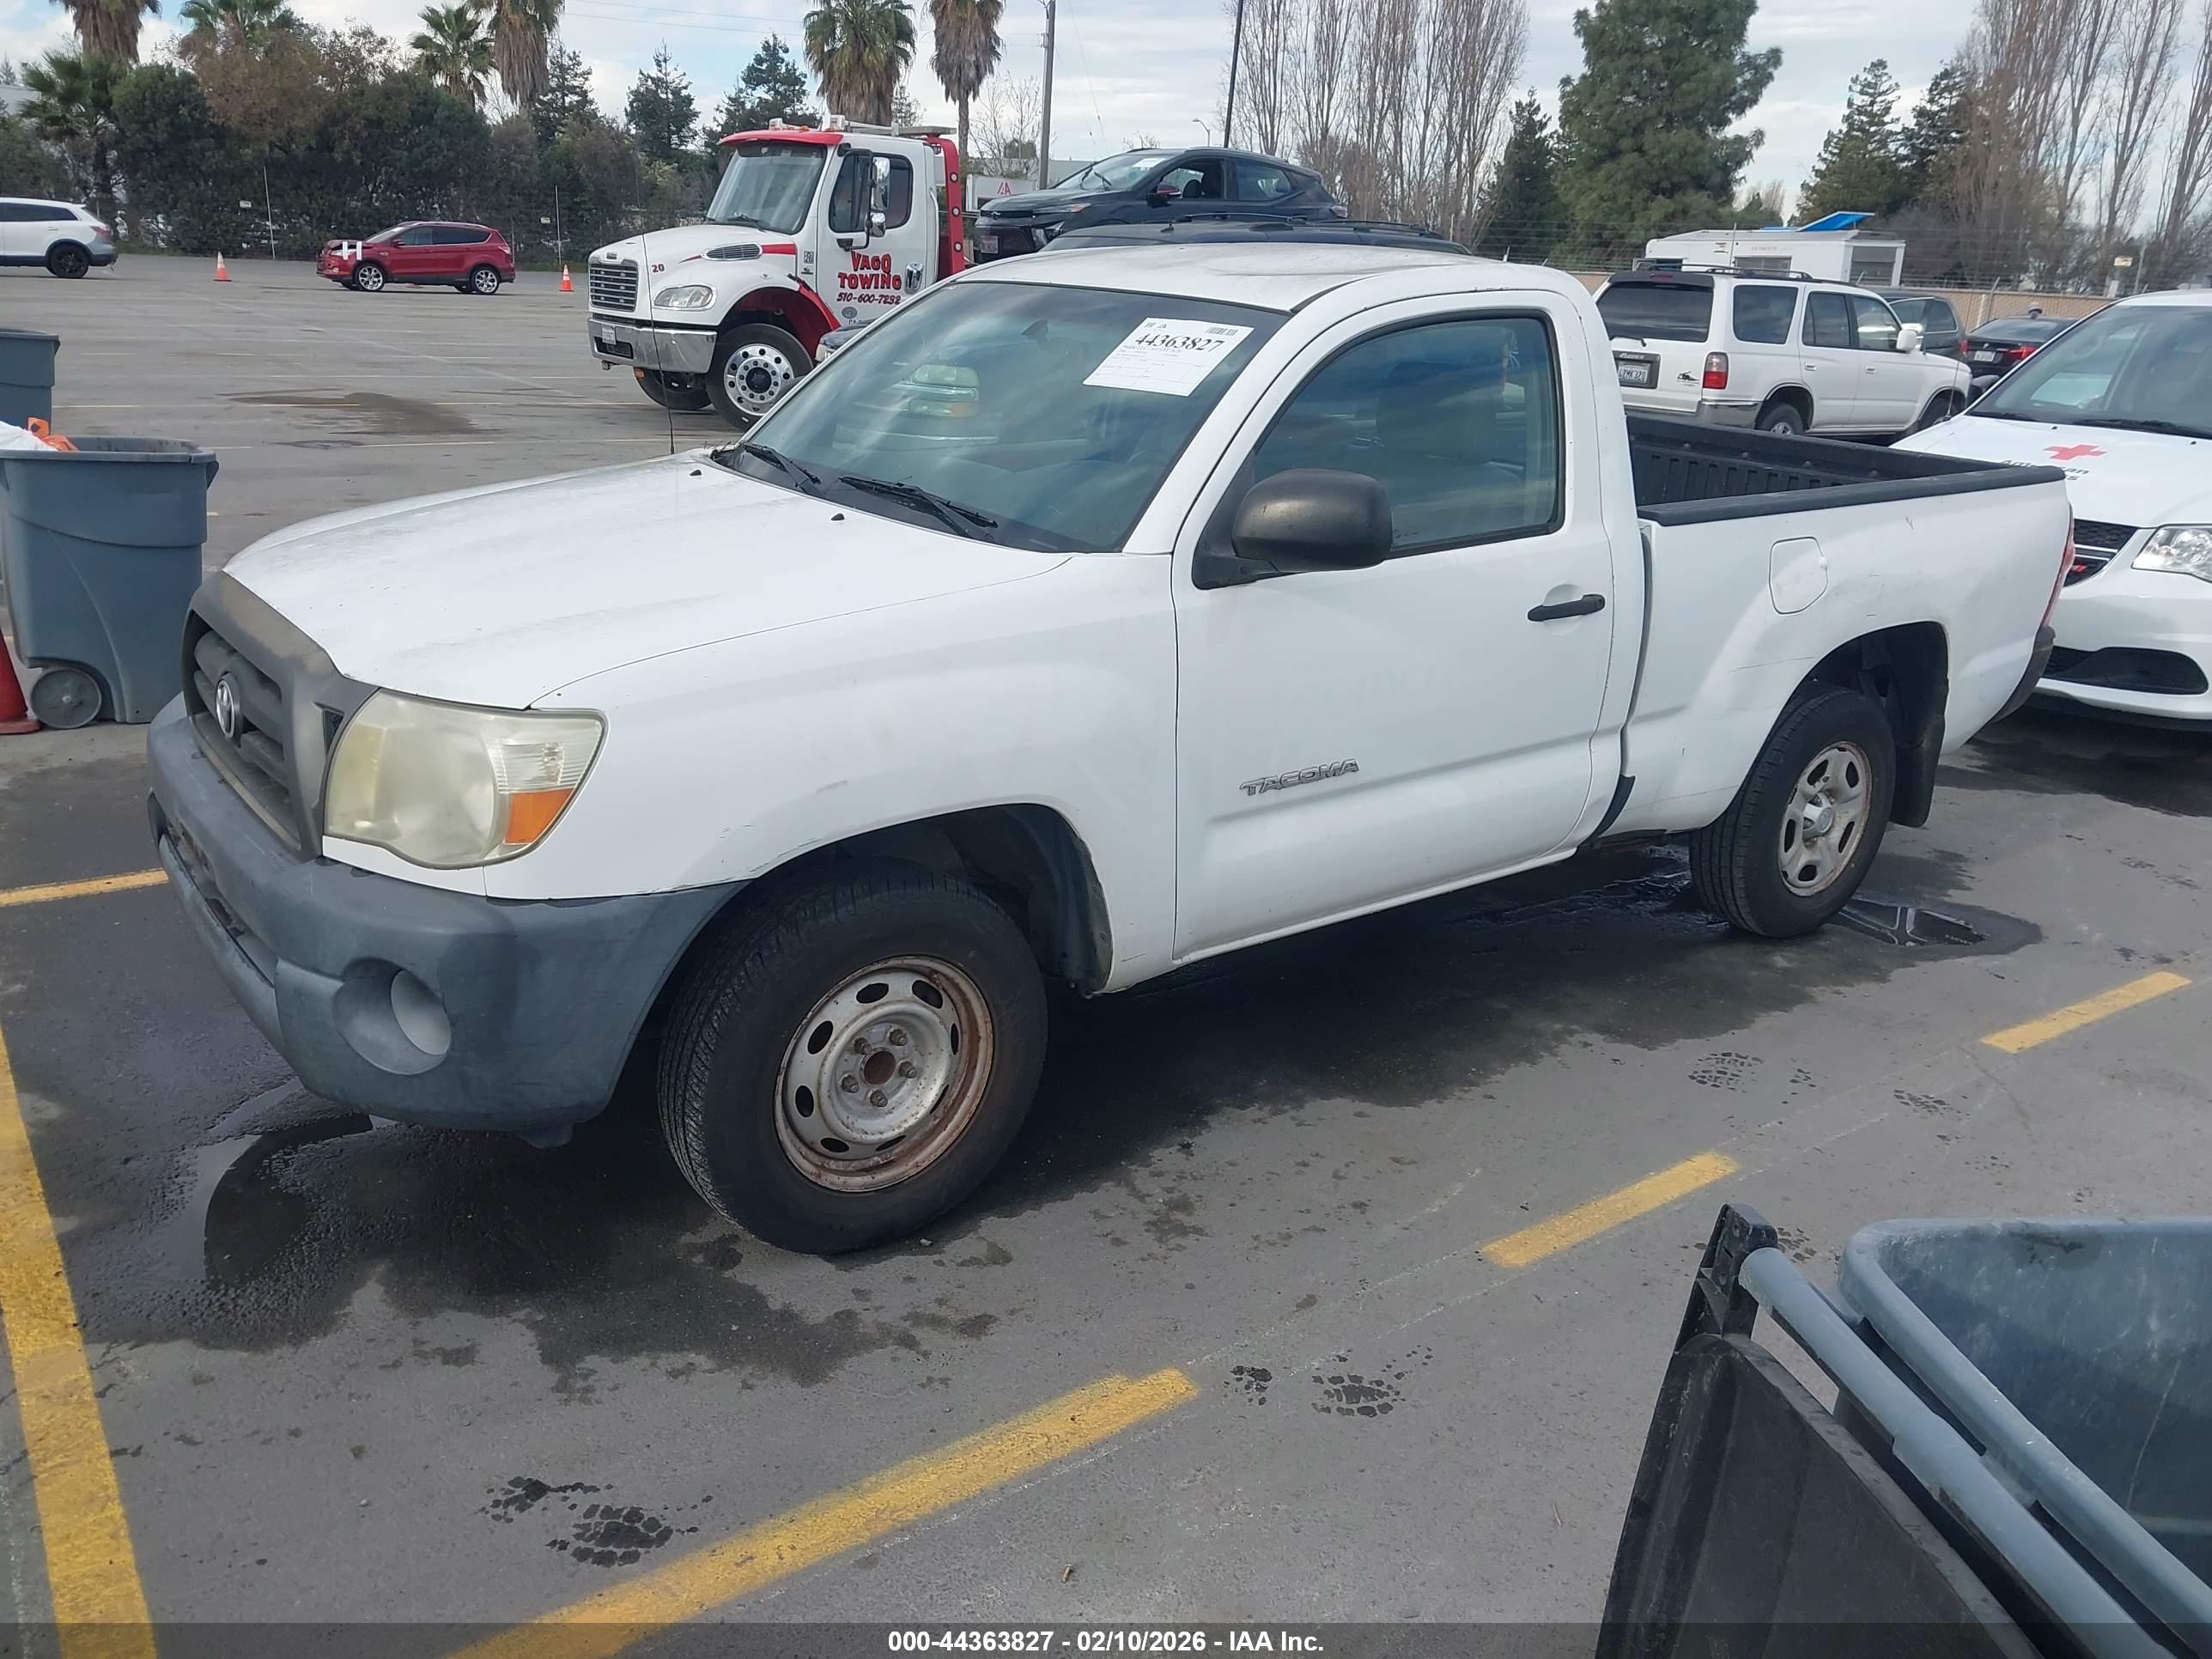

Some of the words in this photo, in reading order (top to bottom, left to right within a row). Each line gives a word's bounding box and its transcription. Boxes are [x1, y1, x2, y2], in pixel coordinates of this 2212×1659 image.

[652, 264, 665, 273] 20
[837, 272, 902, 290] TOWING
[1135, 332, 1225, 352] 44363827
[1239, 757, 1360, 797] TACOMA
